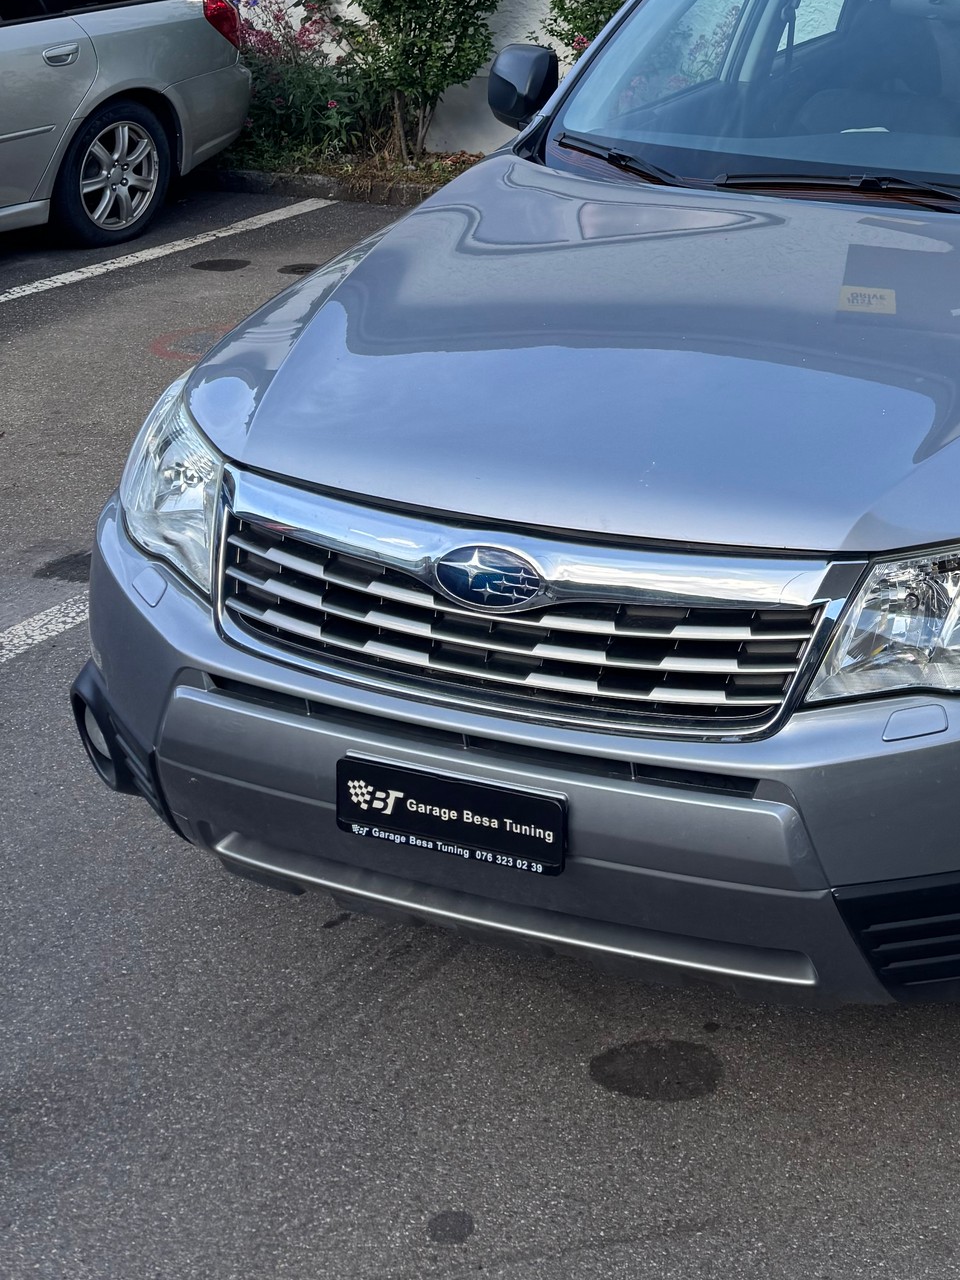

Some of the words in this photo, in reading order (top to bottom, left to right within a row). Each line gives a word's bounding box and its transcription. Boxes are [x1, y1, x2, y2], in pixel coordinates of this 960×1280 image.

[406, 799, 458, 821] Garage
[463, 810, 499, 829] Besa
[503, 818, 554, 843] Tuning
[371, 828, 406, 843] Garage
[409, 836, 433, 849] Besa
[436, 841, 470, 859] Tuning
[475, 850, 493, 862] 076
[495, 855, 513, 867] 323
[516, 859, 528, 870] 02
[530, 862, 543, 873] 39
